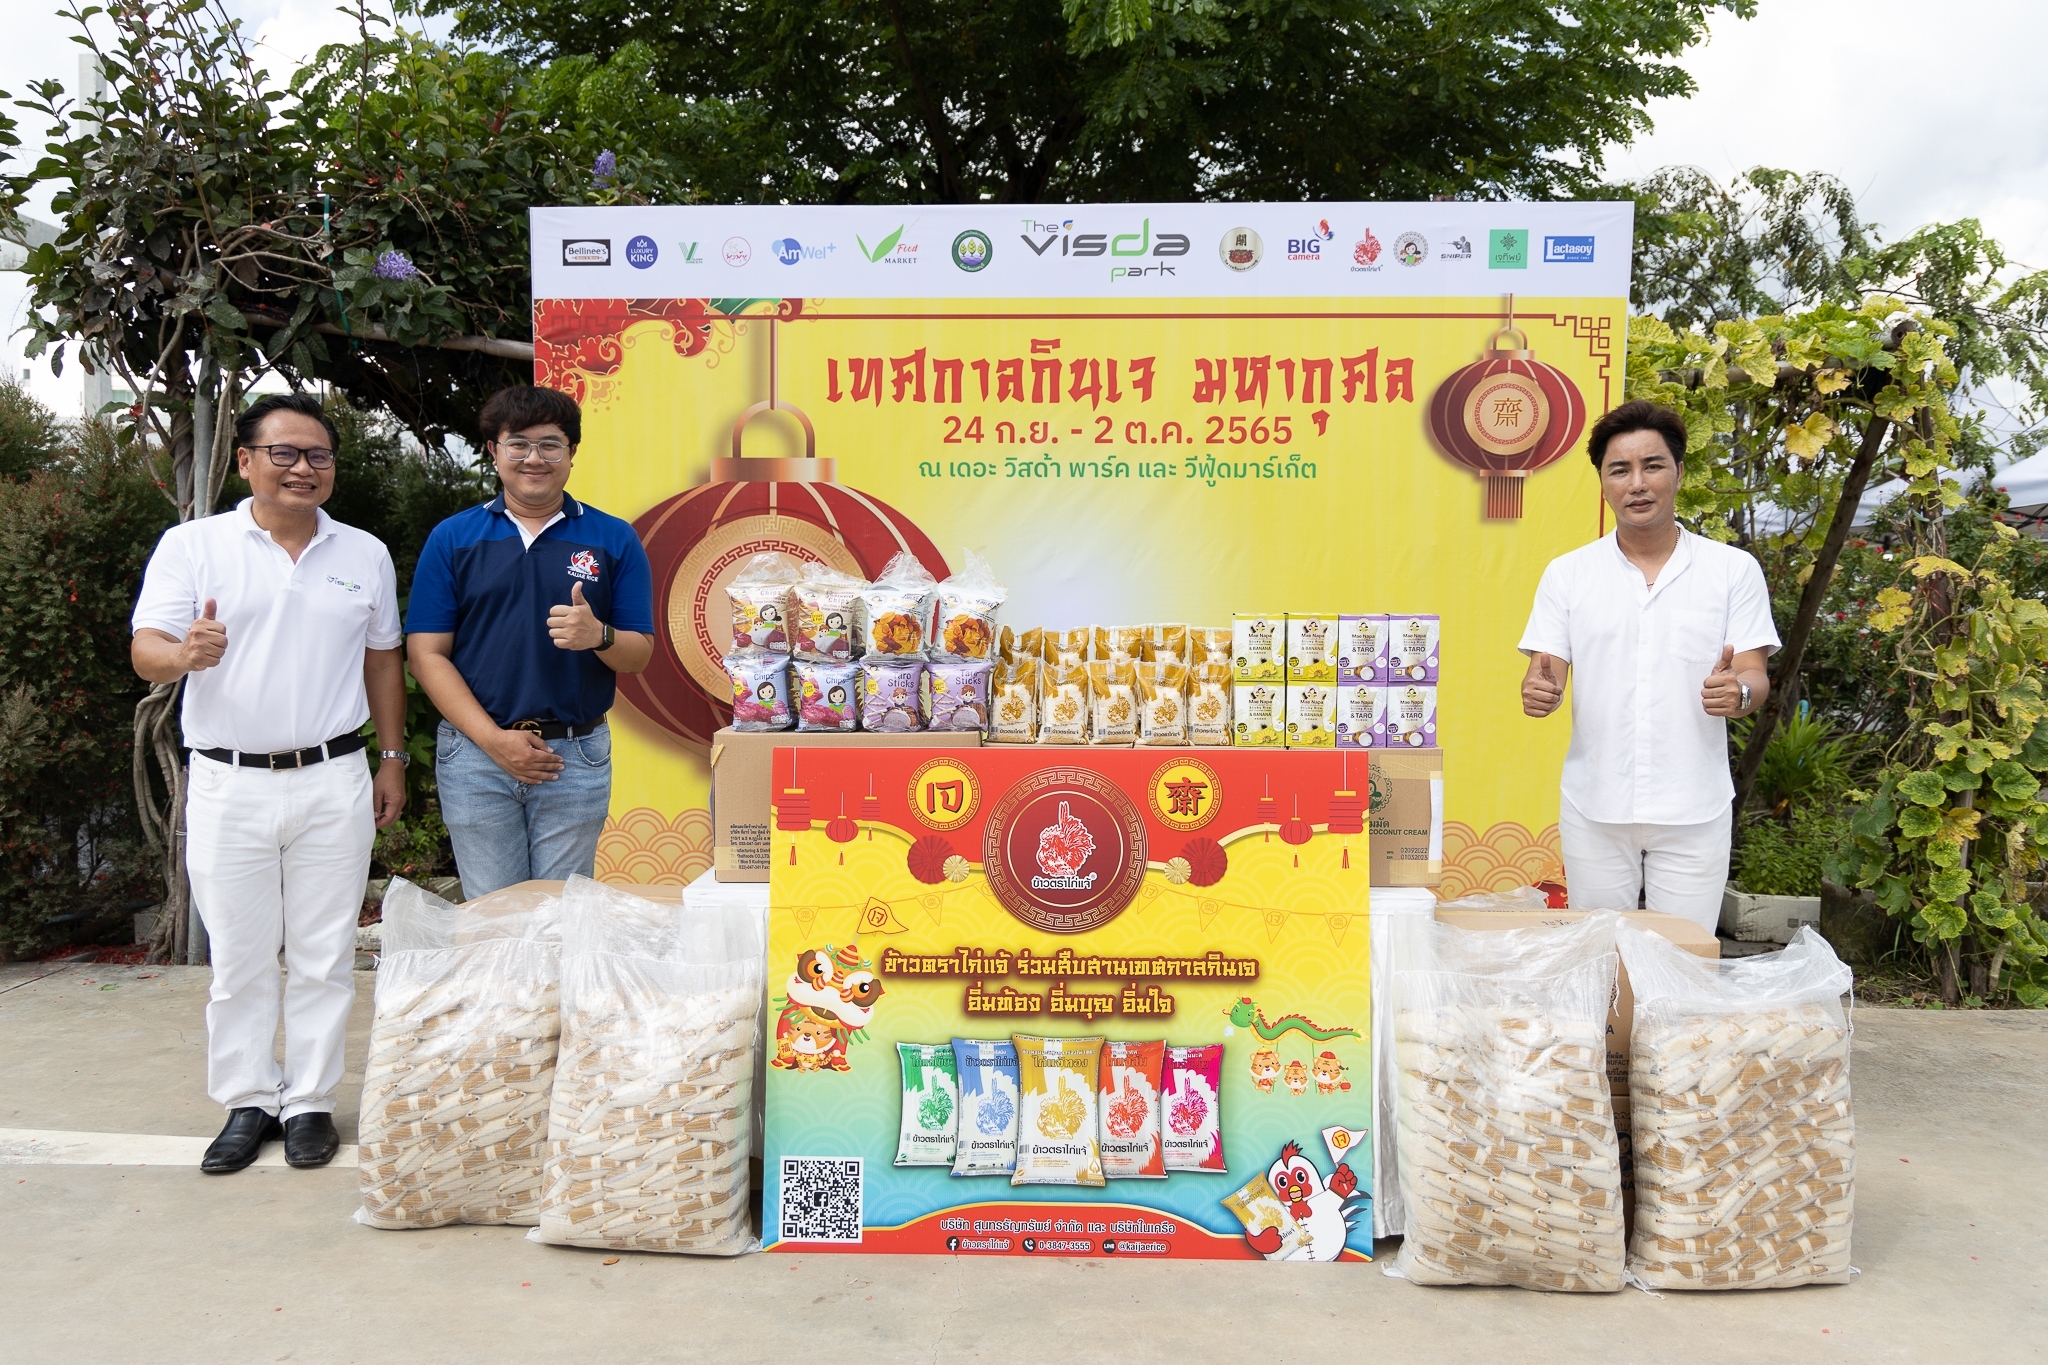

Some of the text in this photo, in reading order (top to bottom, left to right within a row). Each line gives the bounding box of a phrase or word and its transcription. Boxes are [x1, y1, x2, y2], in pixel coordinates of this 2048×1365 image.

[1021, 219, 1059, 233] The
[568, 246, 607, 255] Bellinee's
[1288, 239, 1320, 254] BIG
[1546, 238, 1593, 260] Lactasoy
[630, 254, 654, 262] KING
[1111, 261, 1176, 283] park
[826, 338, 1414, 437] เทศกาลกินเจ มหากุศล
[943, 415, 985, 444] 24
[995, 420, 1059, 444] ก.ย.
[1094, 415, 1114, 444] 2
[1125, 420, 1193, 444] ต.ค.
[1205, 415, 1293, 444] 2565
[918, 453, 1317, 488] ณ เดอะ วิสด้า พาร์ค และ วีฟู้ดมาร์เก็ต
[754, 673, 775, 681] Chips
[825, 677, 846, 685] Chips
[894, 671, 912, 680] Taro
[955, 677, 982, 685] Sticks
[887, 679, 915, 688] Sticks
[926, 779, 965, 815] เจ
[1031, 874, 1093, 891] ข้าวตราไก่แจ้
[883, 948, 1257, 977] ข้าวตราไก่แจ้ ร่วมสืบสานเทศกาลกินเจ
[967, 981, 1172, 1019] อิ่มท้อง อิ่มบุญ อิ่มใจ
[912, 1134, 955, 1143] ข้าวตราไก่แจ้
[971, 1139, 1016, 1150] ข้าวตราไก่แจ้
[1164, 1139, 1209, 1148] ข้าวตราไก่แจ้
[1032, 1143, 1087, 1155] ข้าวตราไก่แจ้
[1101, 1142, 1149, 1153] ข้าวตราไก่แจ้
[941, 1218, 1176, 1234] บริษัท สุนทรธัญทรัพย์ จำกัด และ บริษัทในเครือ
[962, 1238, 1010, 1249] ข้าวตราไก่แจ้
[1118, 1241, 1166, 1253] @kaijaerice
